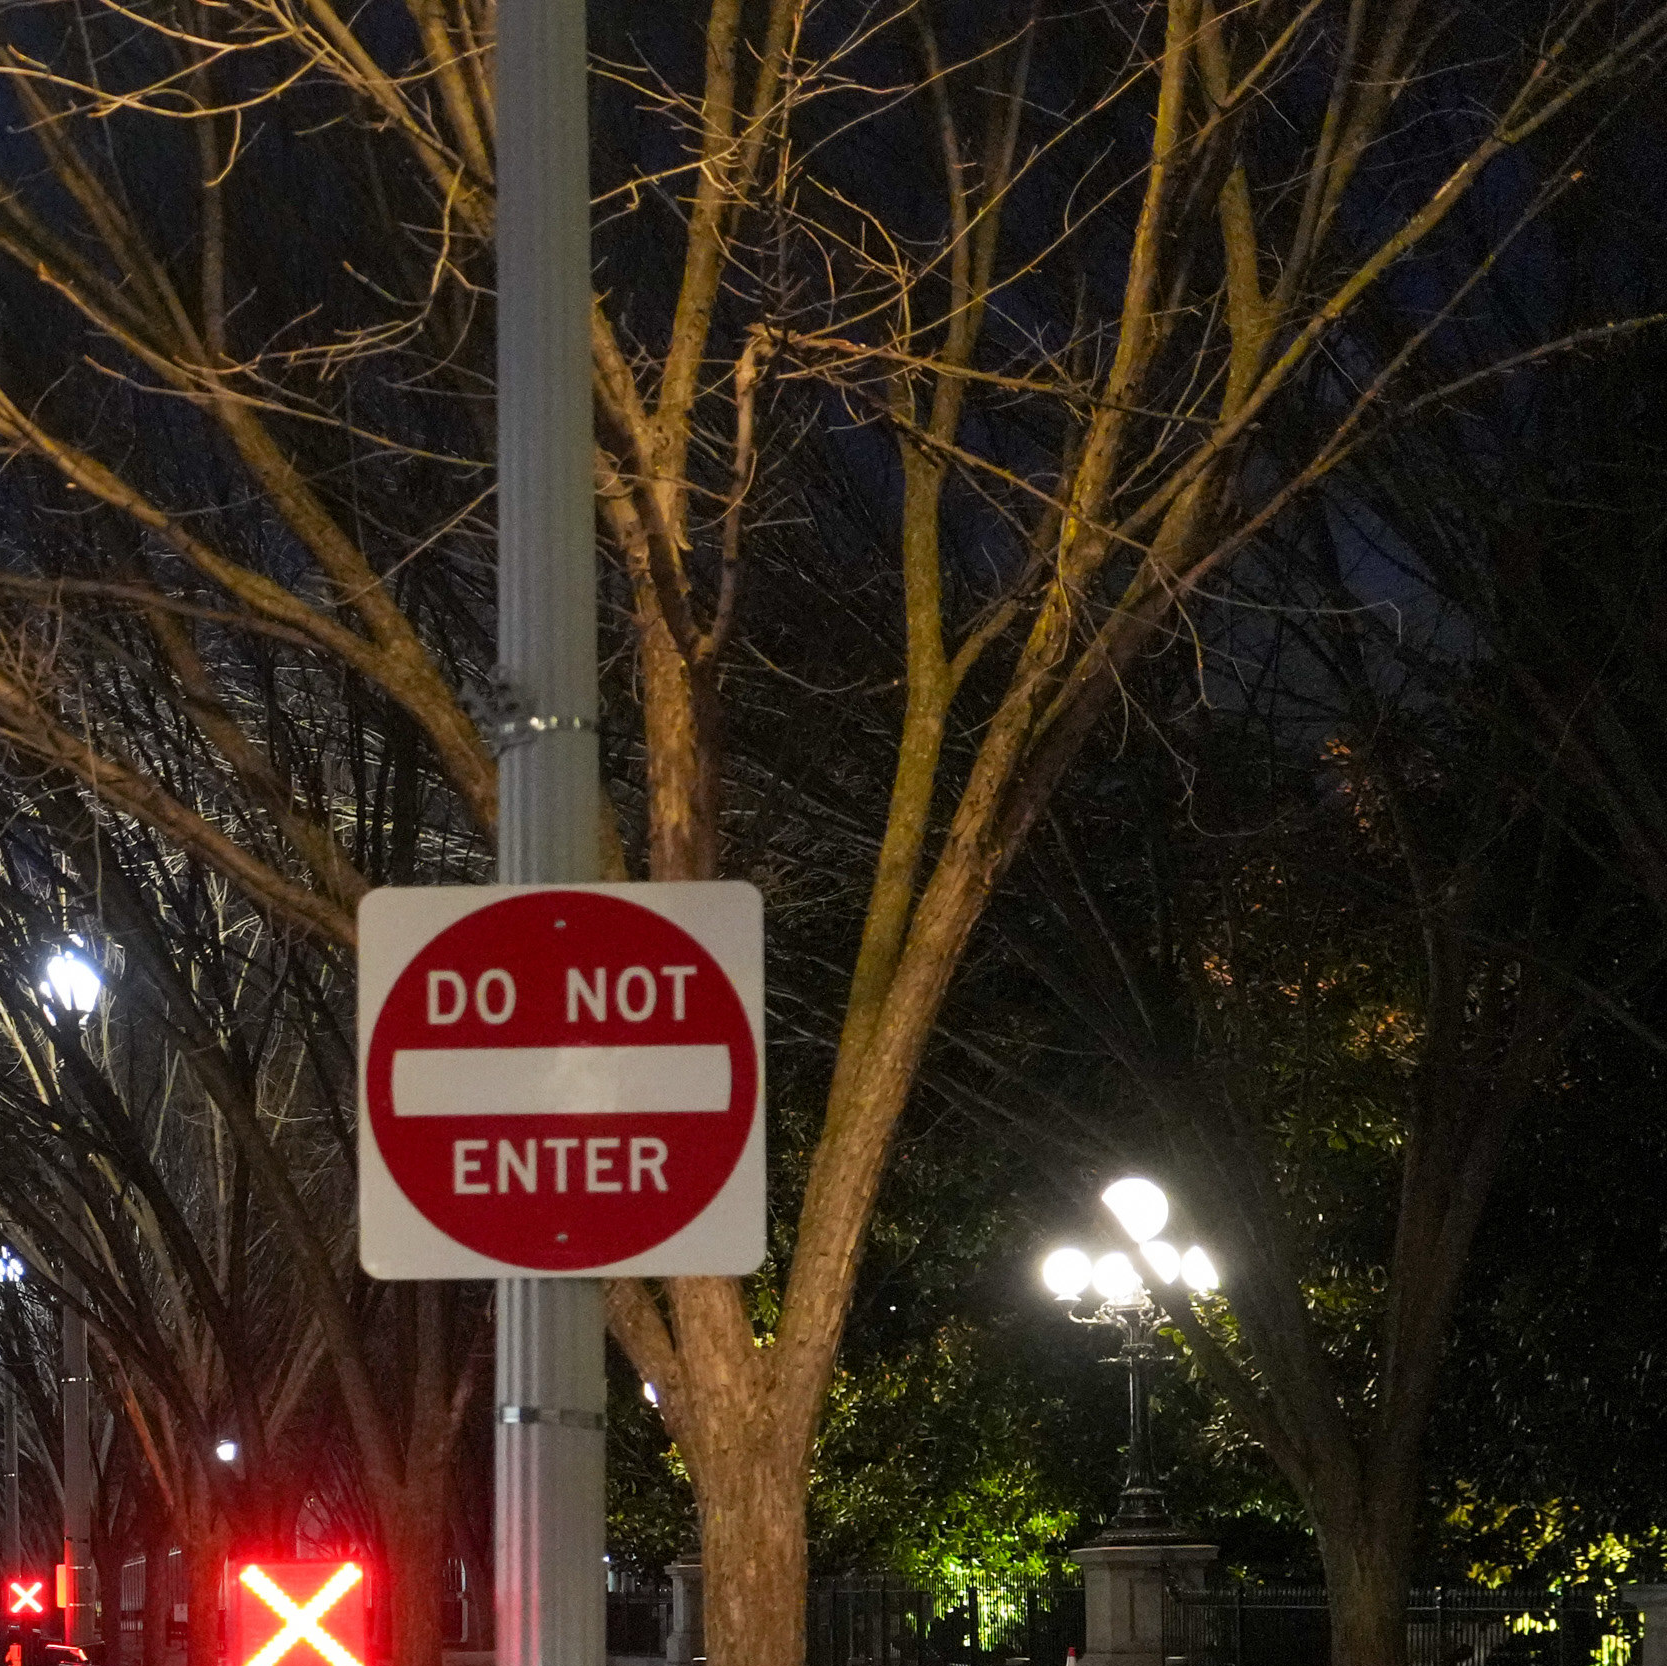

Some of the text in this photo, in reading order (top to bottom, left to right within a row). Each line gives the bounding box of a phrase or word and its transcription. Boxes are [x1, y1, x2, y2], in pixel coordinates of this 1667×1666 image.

[427, 965, 697, 1025] DO NOT
[453, 1137, 668, 1194] ENTER
